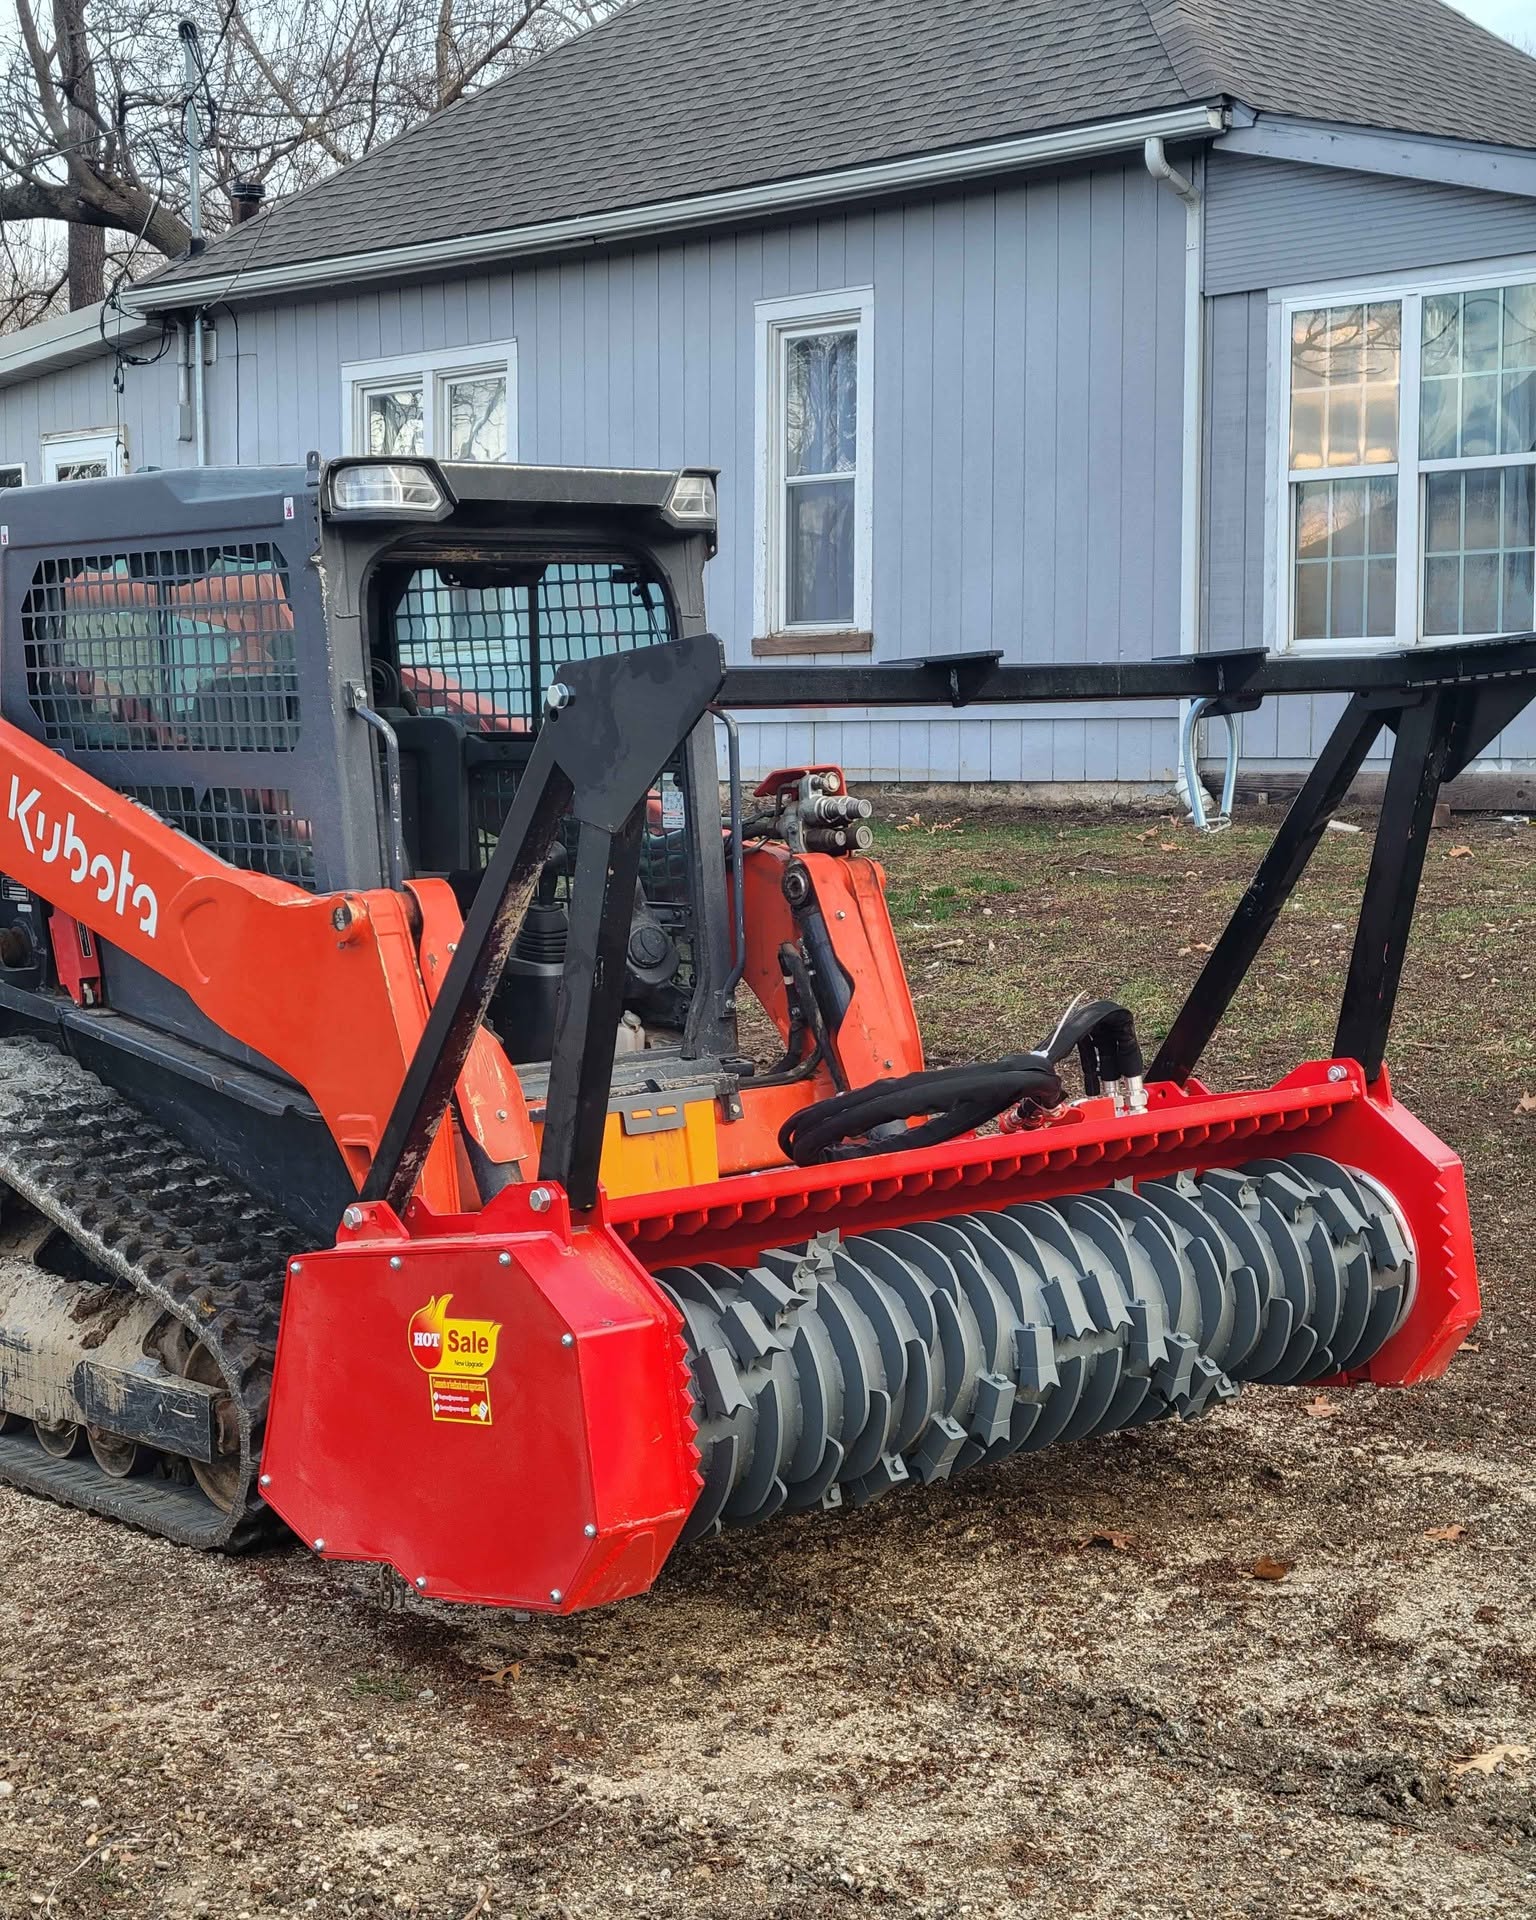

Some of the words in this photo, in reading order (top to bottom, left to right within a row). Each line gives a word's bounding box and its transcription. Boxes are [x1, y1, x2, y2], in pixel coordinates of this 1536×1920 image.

[8, 774, 158, 938] Kubota
[413, 1332, 440, 1347] HOT
[447, 1329, 489, 1354] Sale
[464, 1361, 484, 1369] Upgrade
